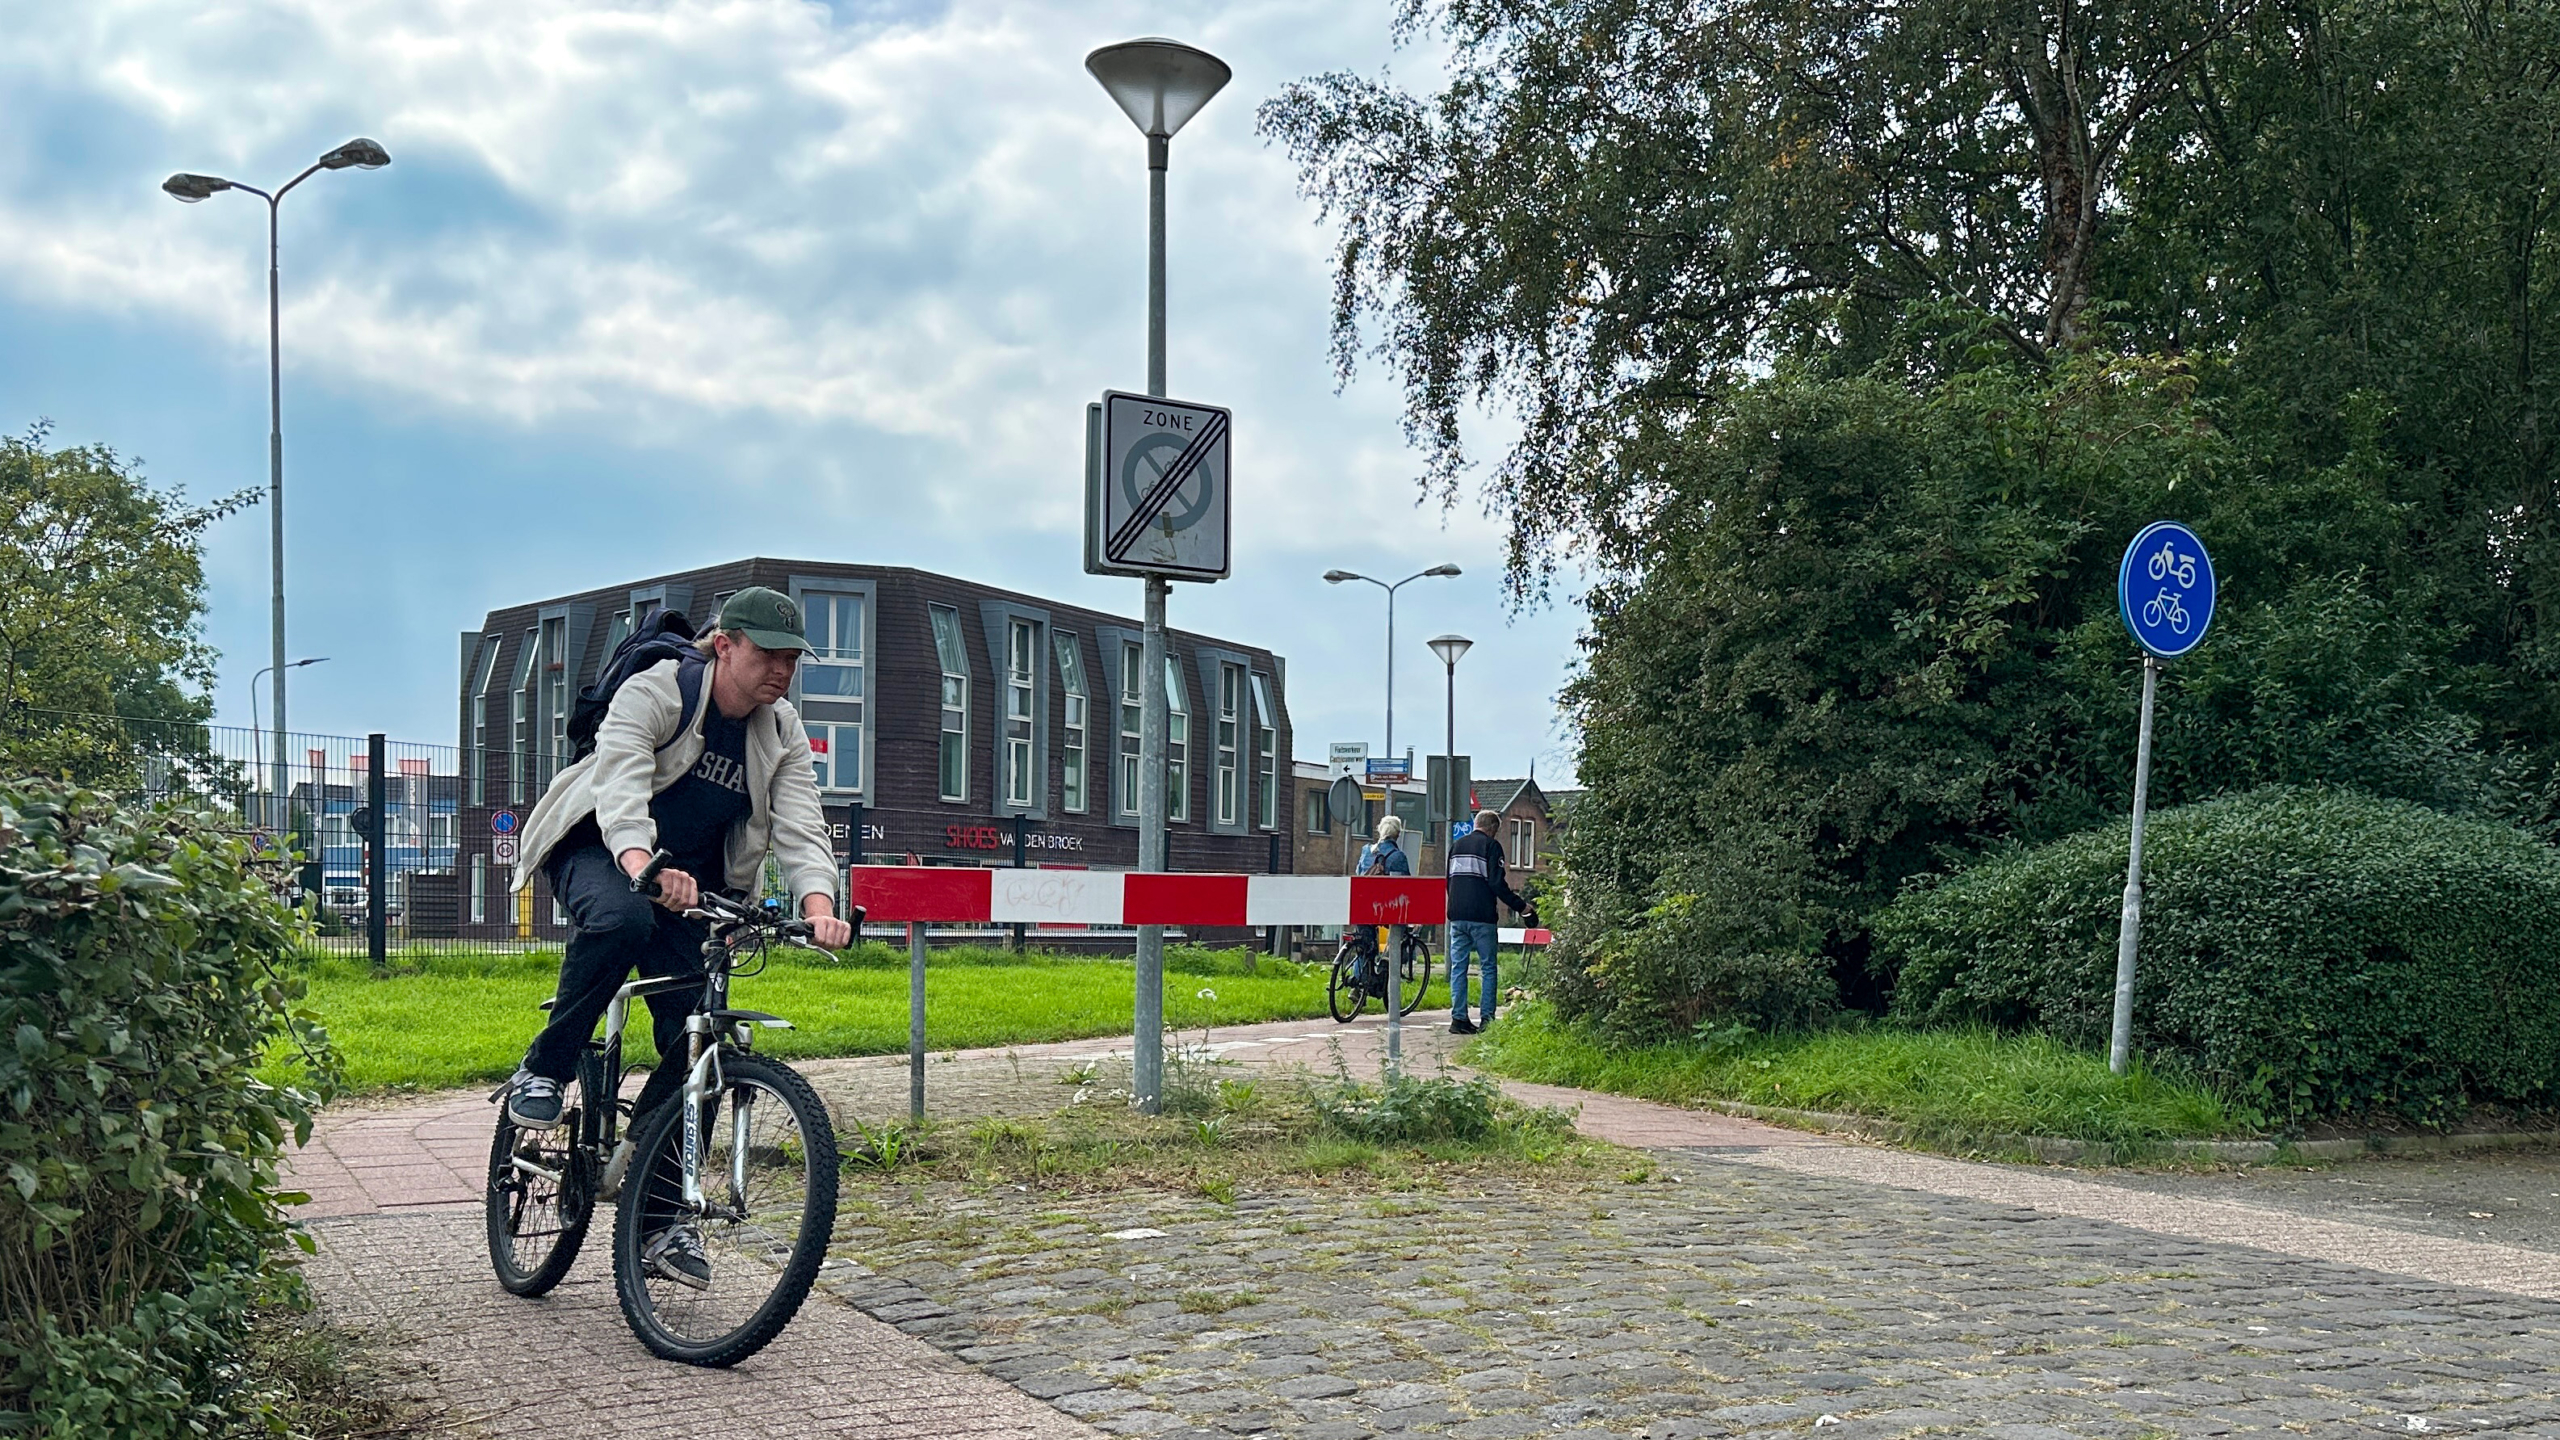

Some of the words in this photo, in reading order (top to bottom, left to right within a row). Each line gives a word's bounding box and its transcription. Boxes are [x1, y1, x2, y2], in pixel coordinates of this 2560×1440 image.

[1143, 409, 1193, 431] ZONE
[946, 824, 997, 850] SHOES
[1000, 832, 1015, 846] VA
[1024, 833, 1045, 849] DEN
[1048, 835, 1083, 851] BROEK
